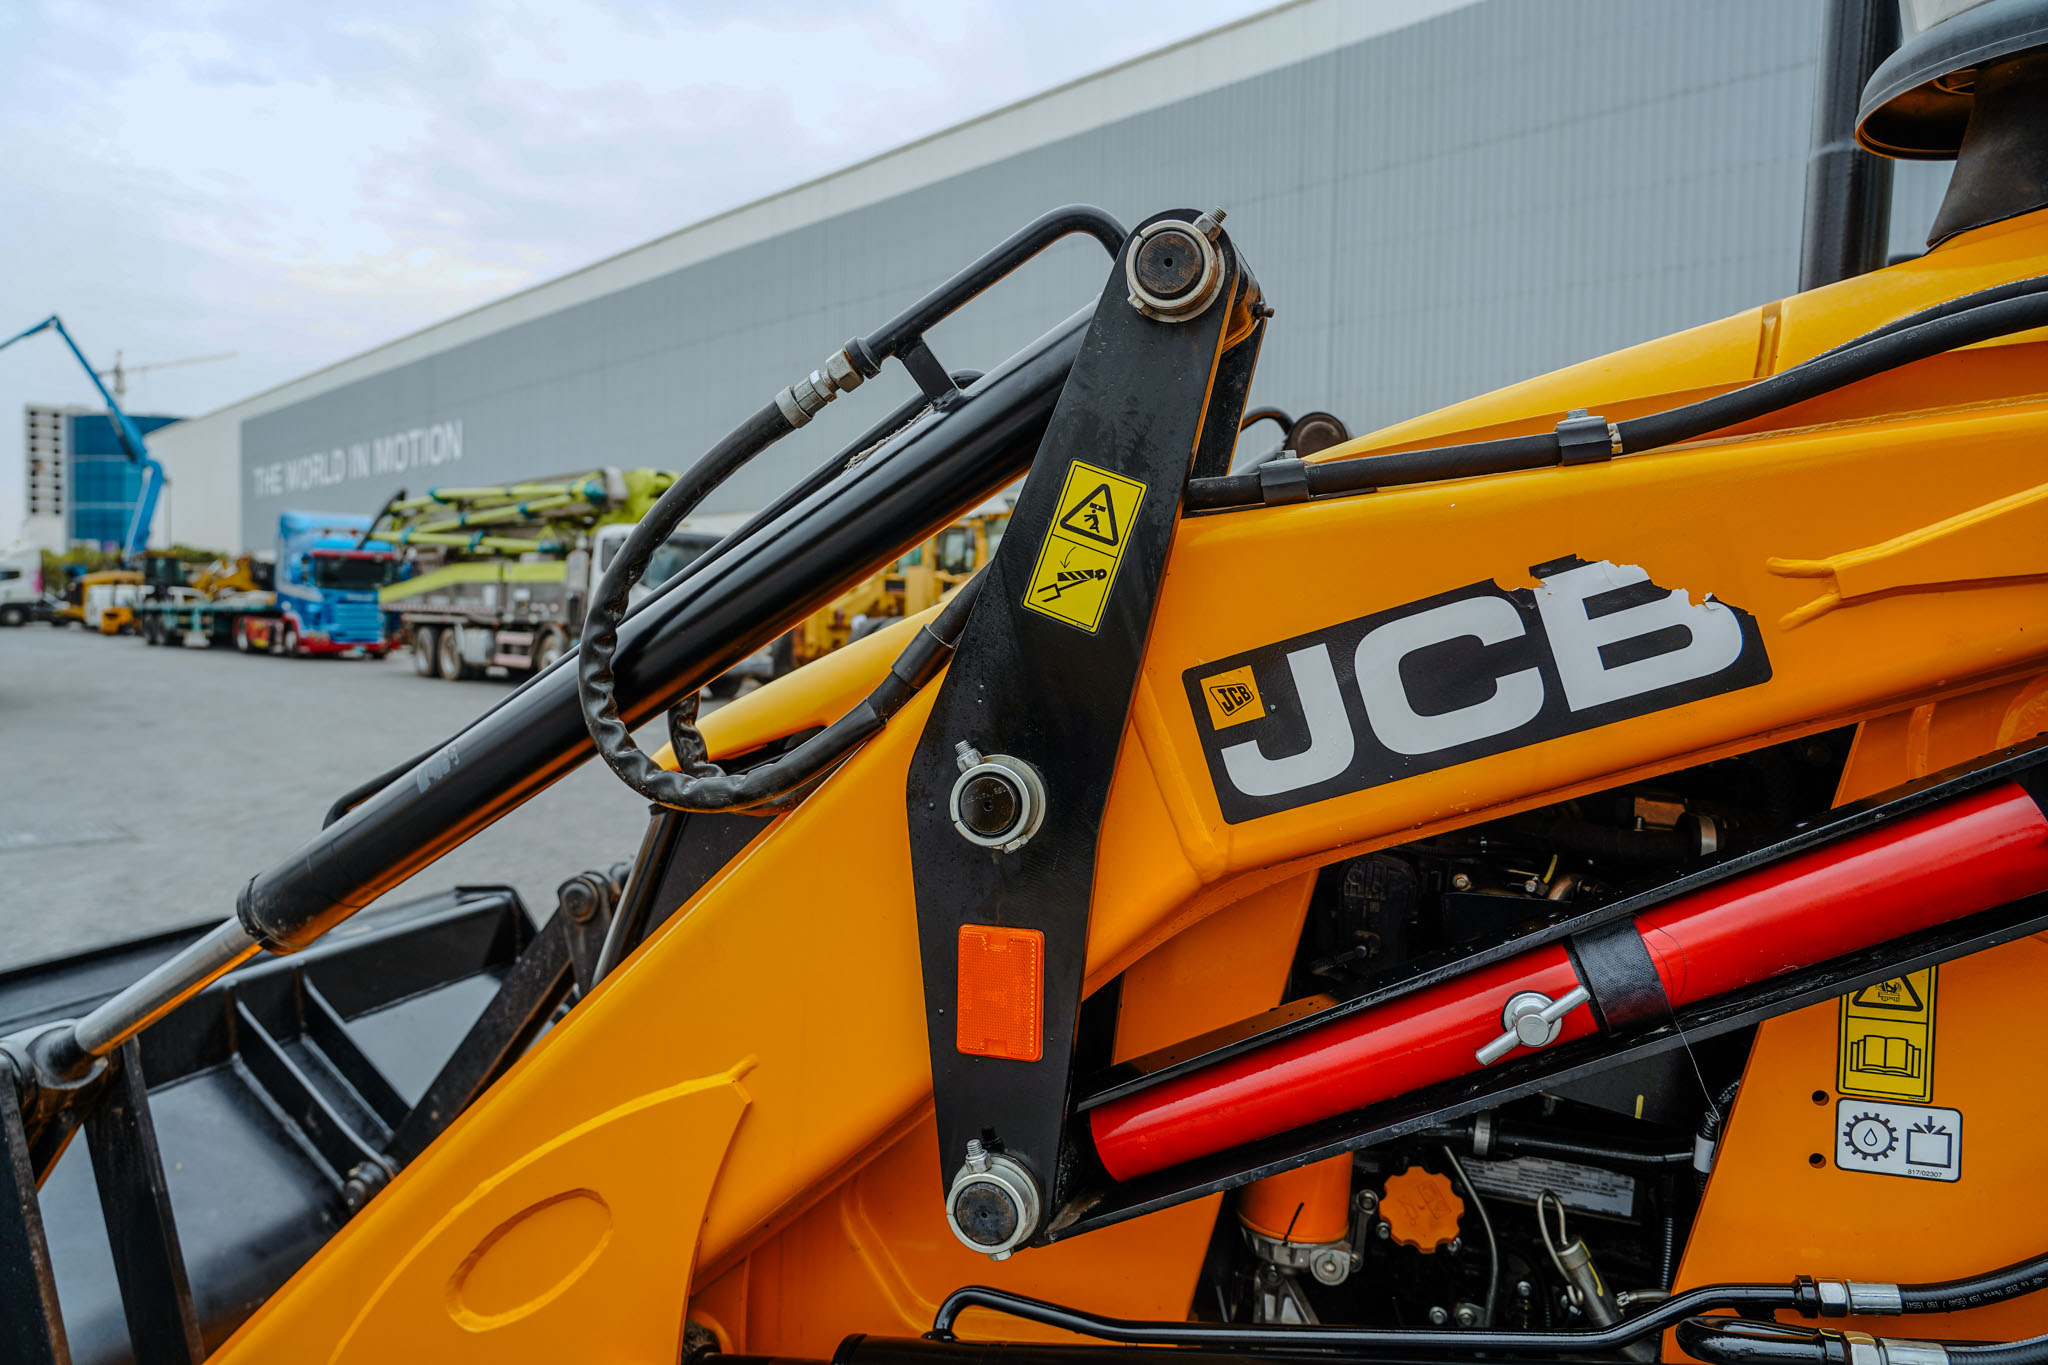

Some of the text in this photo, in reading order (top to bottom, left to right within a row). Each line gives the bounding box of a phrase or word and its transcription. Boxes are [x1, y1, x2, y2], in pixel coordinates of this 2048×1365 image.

[254, 419, 463, 497] THE WORLD IN MOTION
[1217, 686, 1251, 712] JCB
[1220, 560, 1744, 797] JCB
[1907, 1168, 1942, 1178] 817/02307
